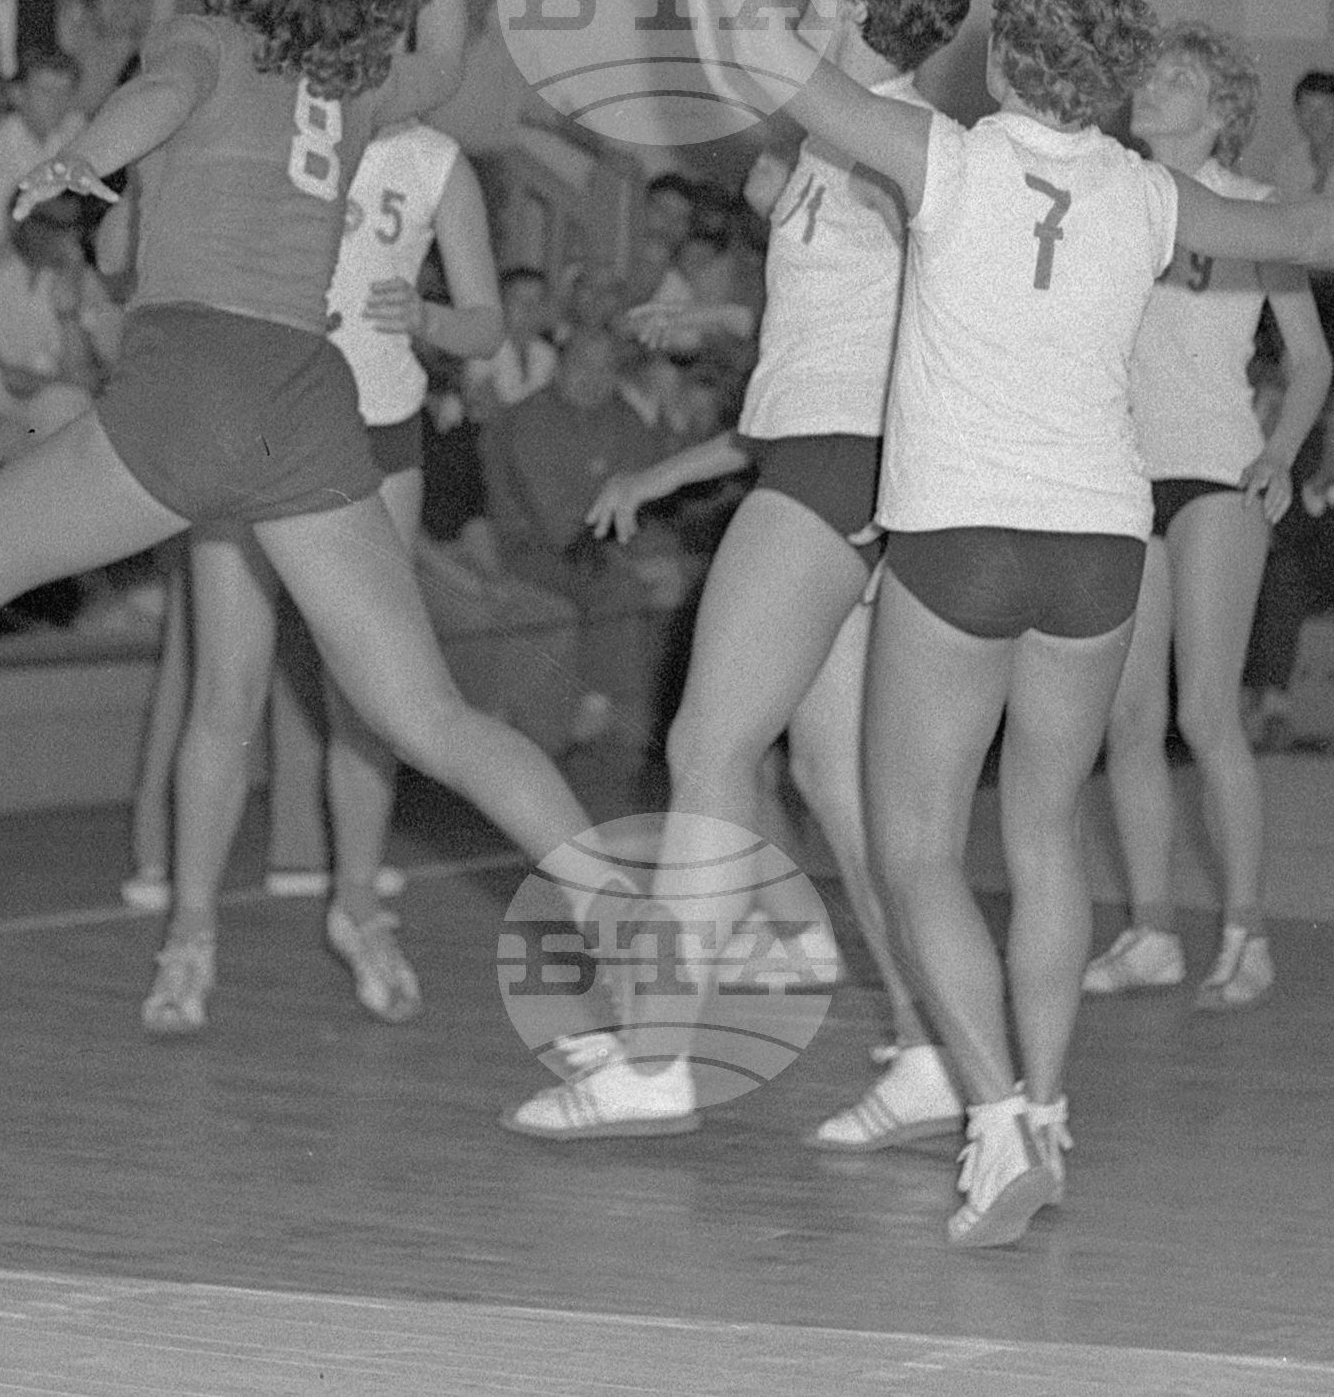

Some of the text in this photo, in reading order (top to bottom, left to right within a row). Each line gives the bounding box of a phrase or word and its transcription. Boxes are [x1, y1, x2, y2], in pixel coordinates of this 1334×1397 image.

[288, 77, 342, 202] 8
[375, 188, 408, 245] 5
[1024, 172, 1072, 291] 7
